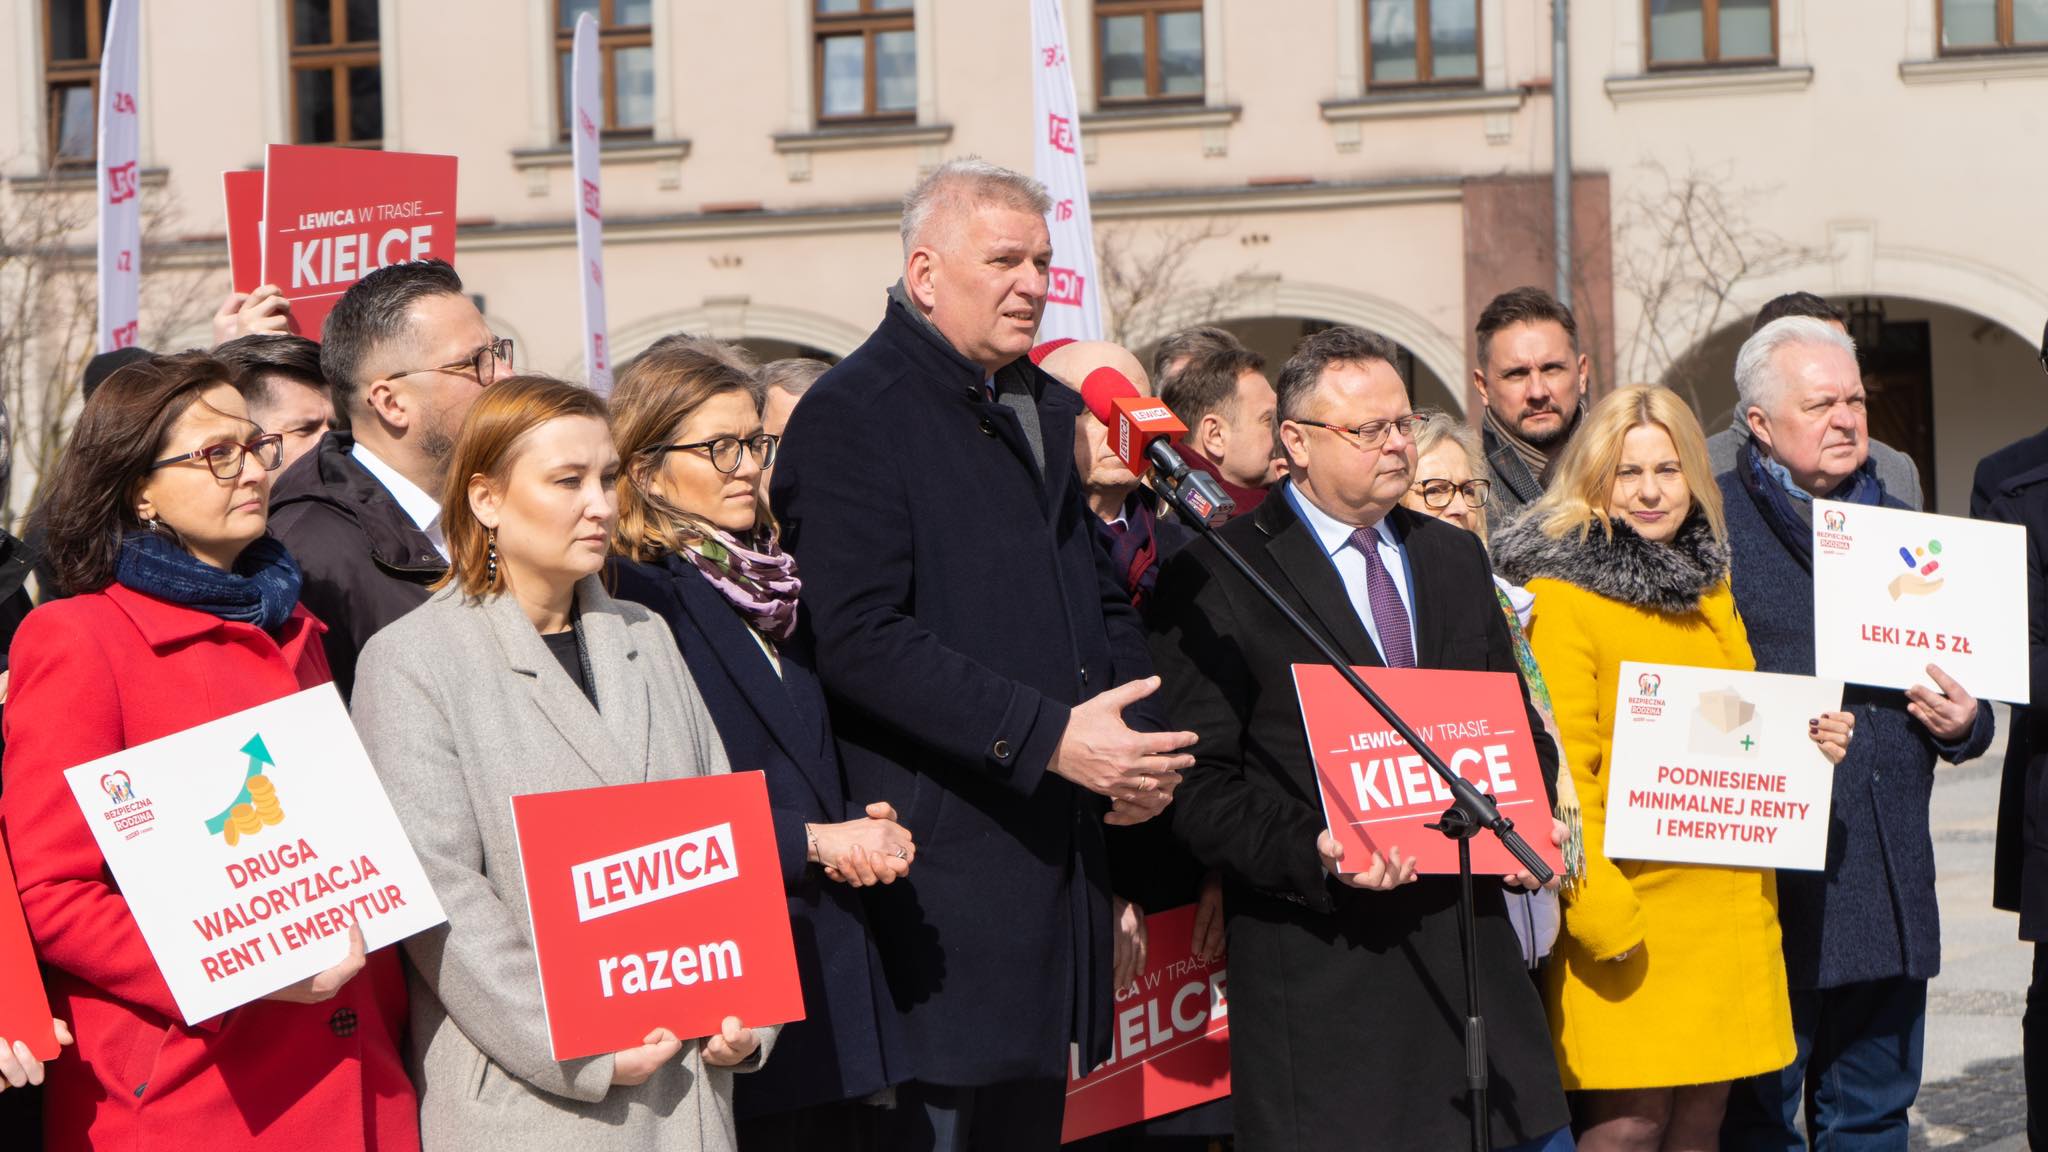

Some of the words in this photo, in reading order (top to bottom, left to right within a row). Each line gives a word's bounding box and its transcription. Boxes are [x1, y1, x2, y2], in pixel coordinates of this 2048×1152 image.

[299, 209, 355, 230] LEWICA
[359, 206, 374, 223] W
[377, 200, 423, 221] TRASIE
[292, 225, 433, 289] KIELCE
[1134, 409, 1168, 420] LEWICA
[1861, 623, 1900, 645] LEKI
[1906, 629, 1930, 649] ZA
[1936, 634, 1946, 650] 5
[1951, 636, 1973, 654] ZŁ
[1350, 729, 1408, 751] LEWIC
[1416, 725, 1434, 743] W
[1437, 720, 1490, 741] TRASIE
[1350, 744, 1518, 811] KIELCE
[1657, 766, 1787, 793] PODNIESIENIE
[104, 798, 152, 820] BEZPIECZNA
[1628, 790, 1746, 815] MINIMALNEJ
[1750, 800, 1810, 820] RENTY
[115, 811, 154, 831] RODZINA
[1656, 819, 1662, 836] I
[1667, 819, 1778, 843] EMERYTURY
[225, 837, 318, 889] DRUGA
[584, 835, 729, 910] LEWICA
[193, 855, 380, 942] WALORYZACJA
[201, 938, 266, 982] RENT
[267, 931, 282, 956] I
[284, 884, 407, 951] EMERYTUR
[598, 939, 743, 998] razem
[1144, 970, 1162, 991] W
[1070, 969, 1228, 1081] ELCE
